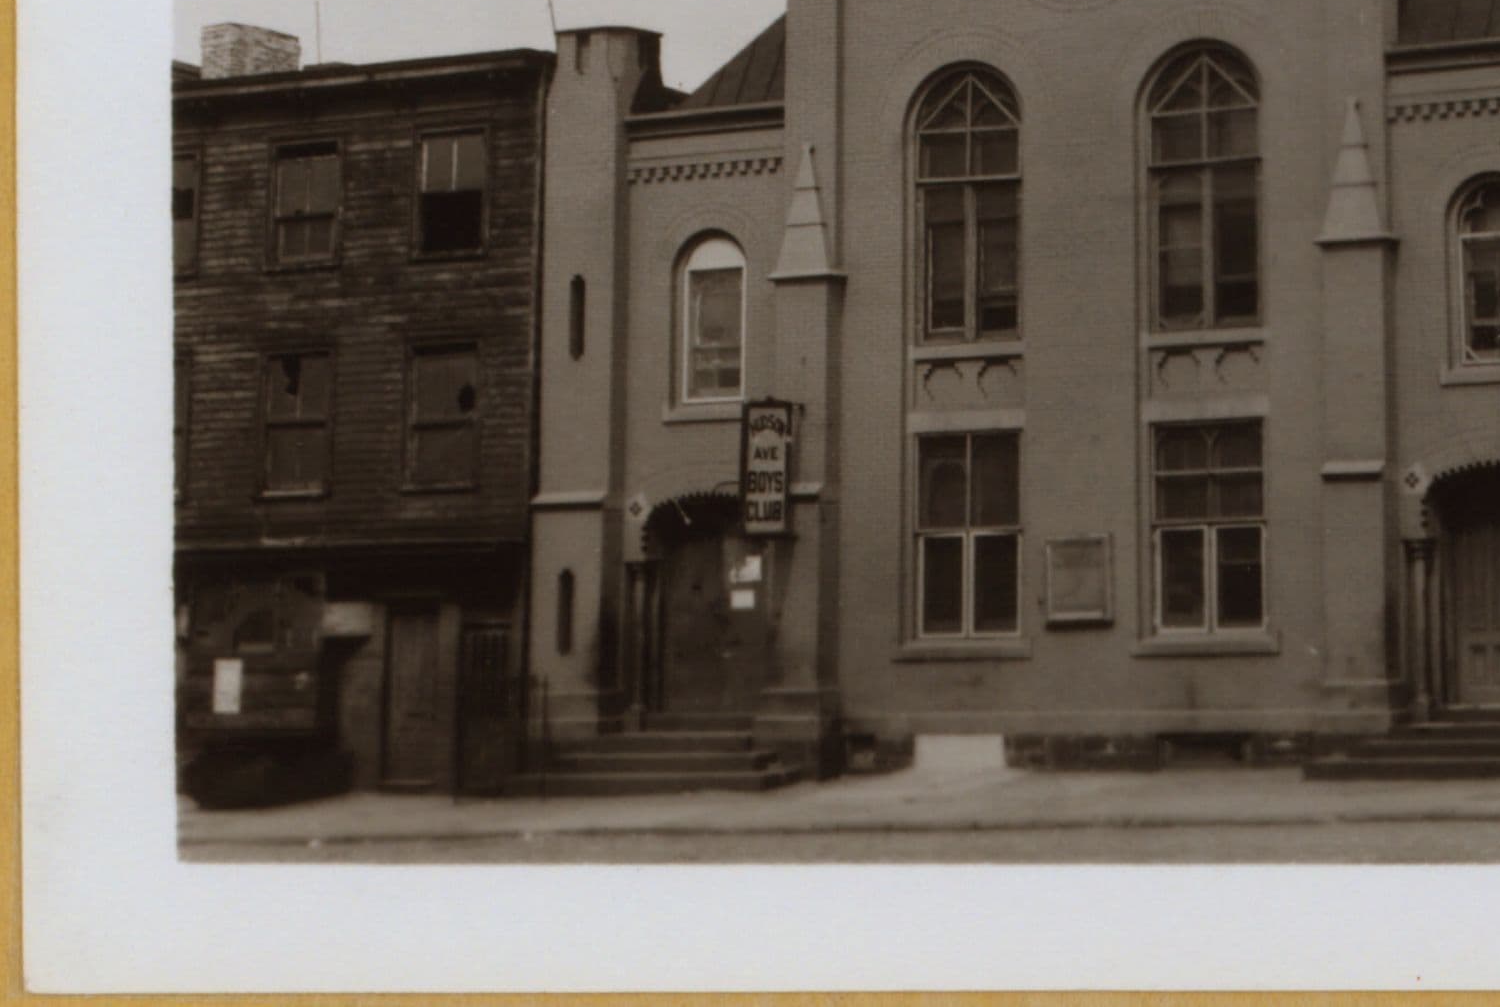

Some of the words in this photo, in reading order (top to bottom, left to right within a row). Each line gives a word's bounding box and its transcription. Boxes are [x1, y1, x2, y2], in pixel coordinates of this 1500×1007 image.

[753, 446, 779, 461] AVE
[747, 470, 783, 494] BOYS
[746, 500, 782, 522] CLUB
